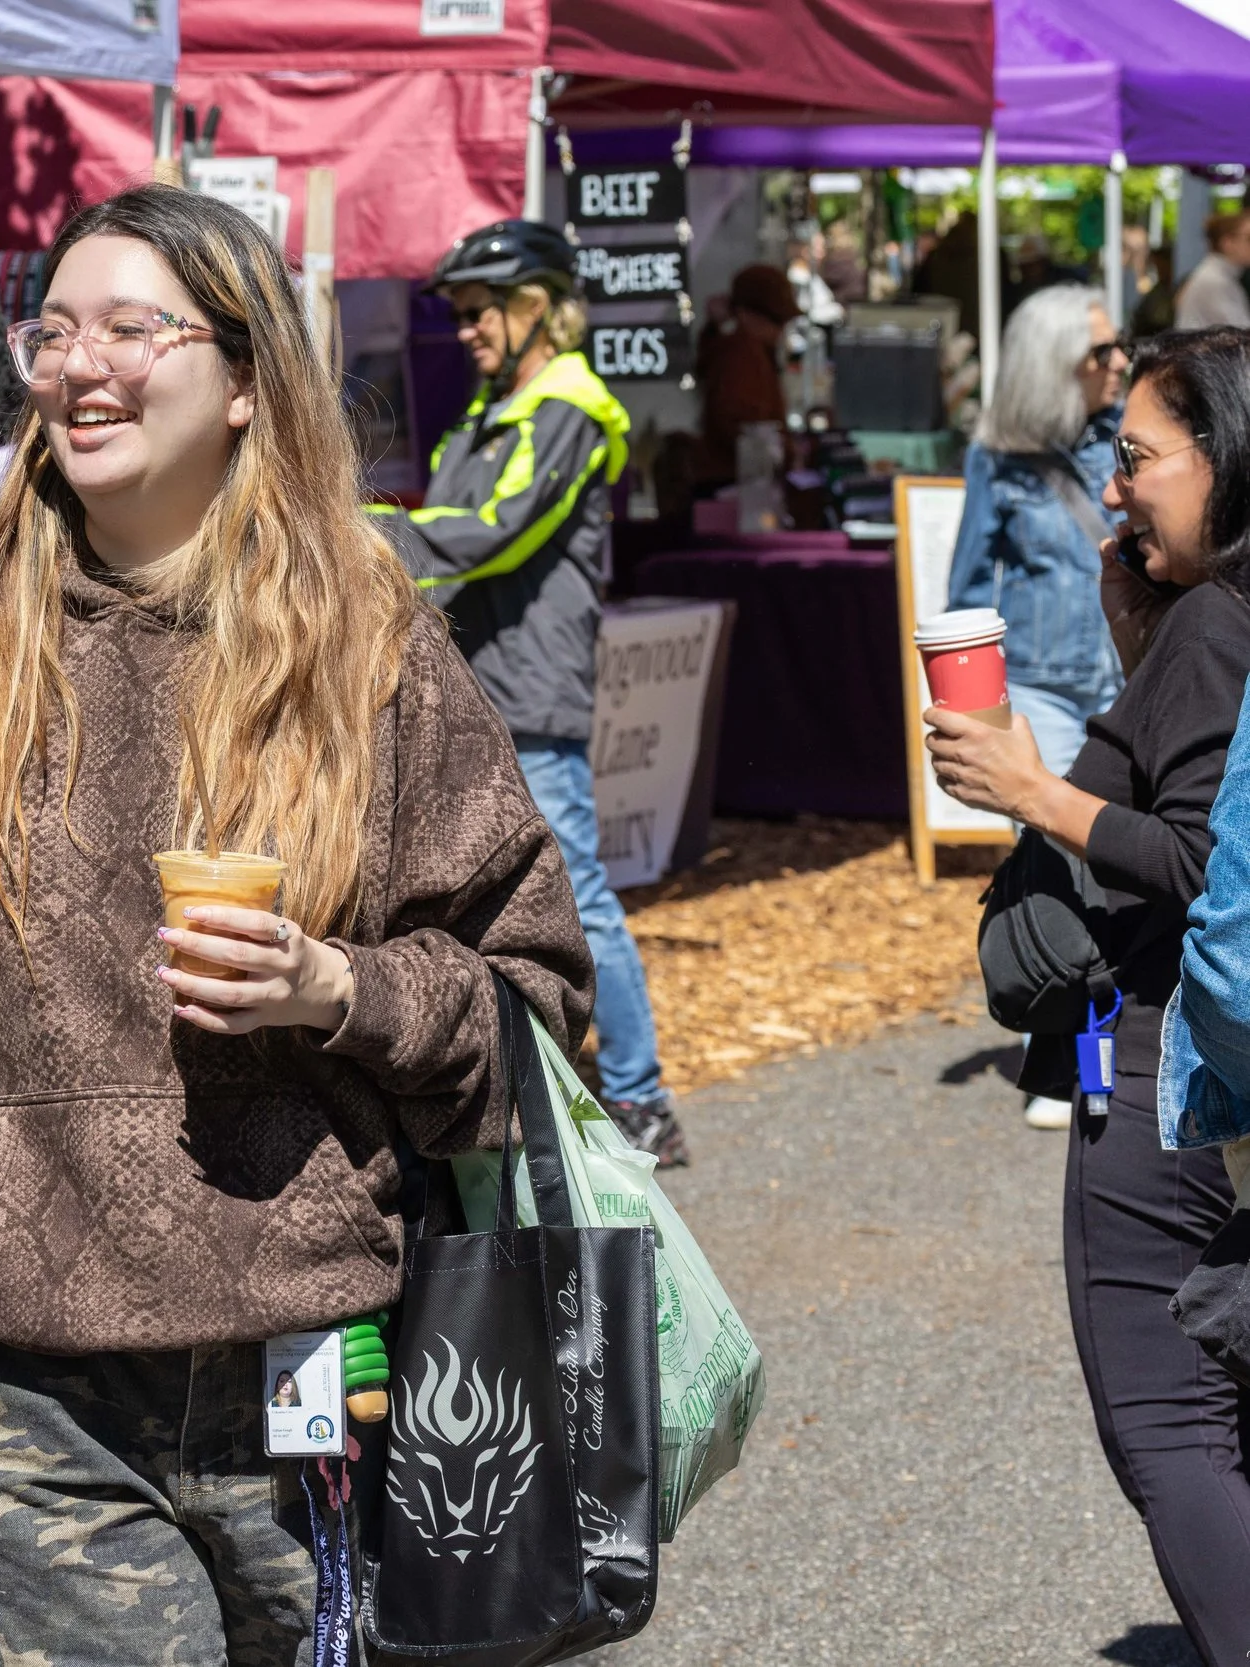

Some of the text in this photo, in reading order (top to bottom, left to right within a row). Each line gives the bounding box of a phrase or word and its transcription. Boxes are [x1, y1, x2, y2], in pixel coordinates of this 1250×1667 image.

[580, 171, 660, 217] BEEF
[603, 252, 683, 296] CHEESE
[593, 327, 668, 375] EGGS
[957, 656, 969, 665] 20
[597, 798, 656, 873] airy
[557, 1267, 578, 1319] Den
[665, 1276, 682, 1324] COMPOST
[583, 1294, 609, 1451] Candle Company
[338, 1563, 351, 1619] weed
[330, 1628, 349, 1667] oke
